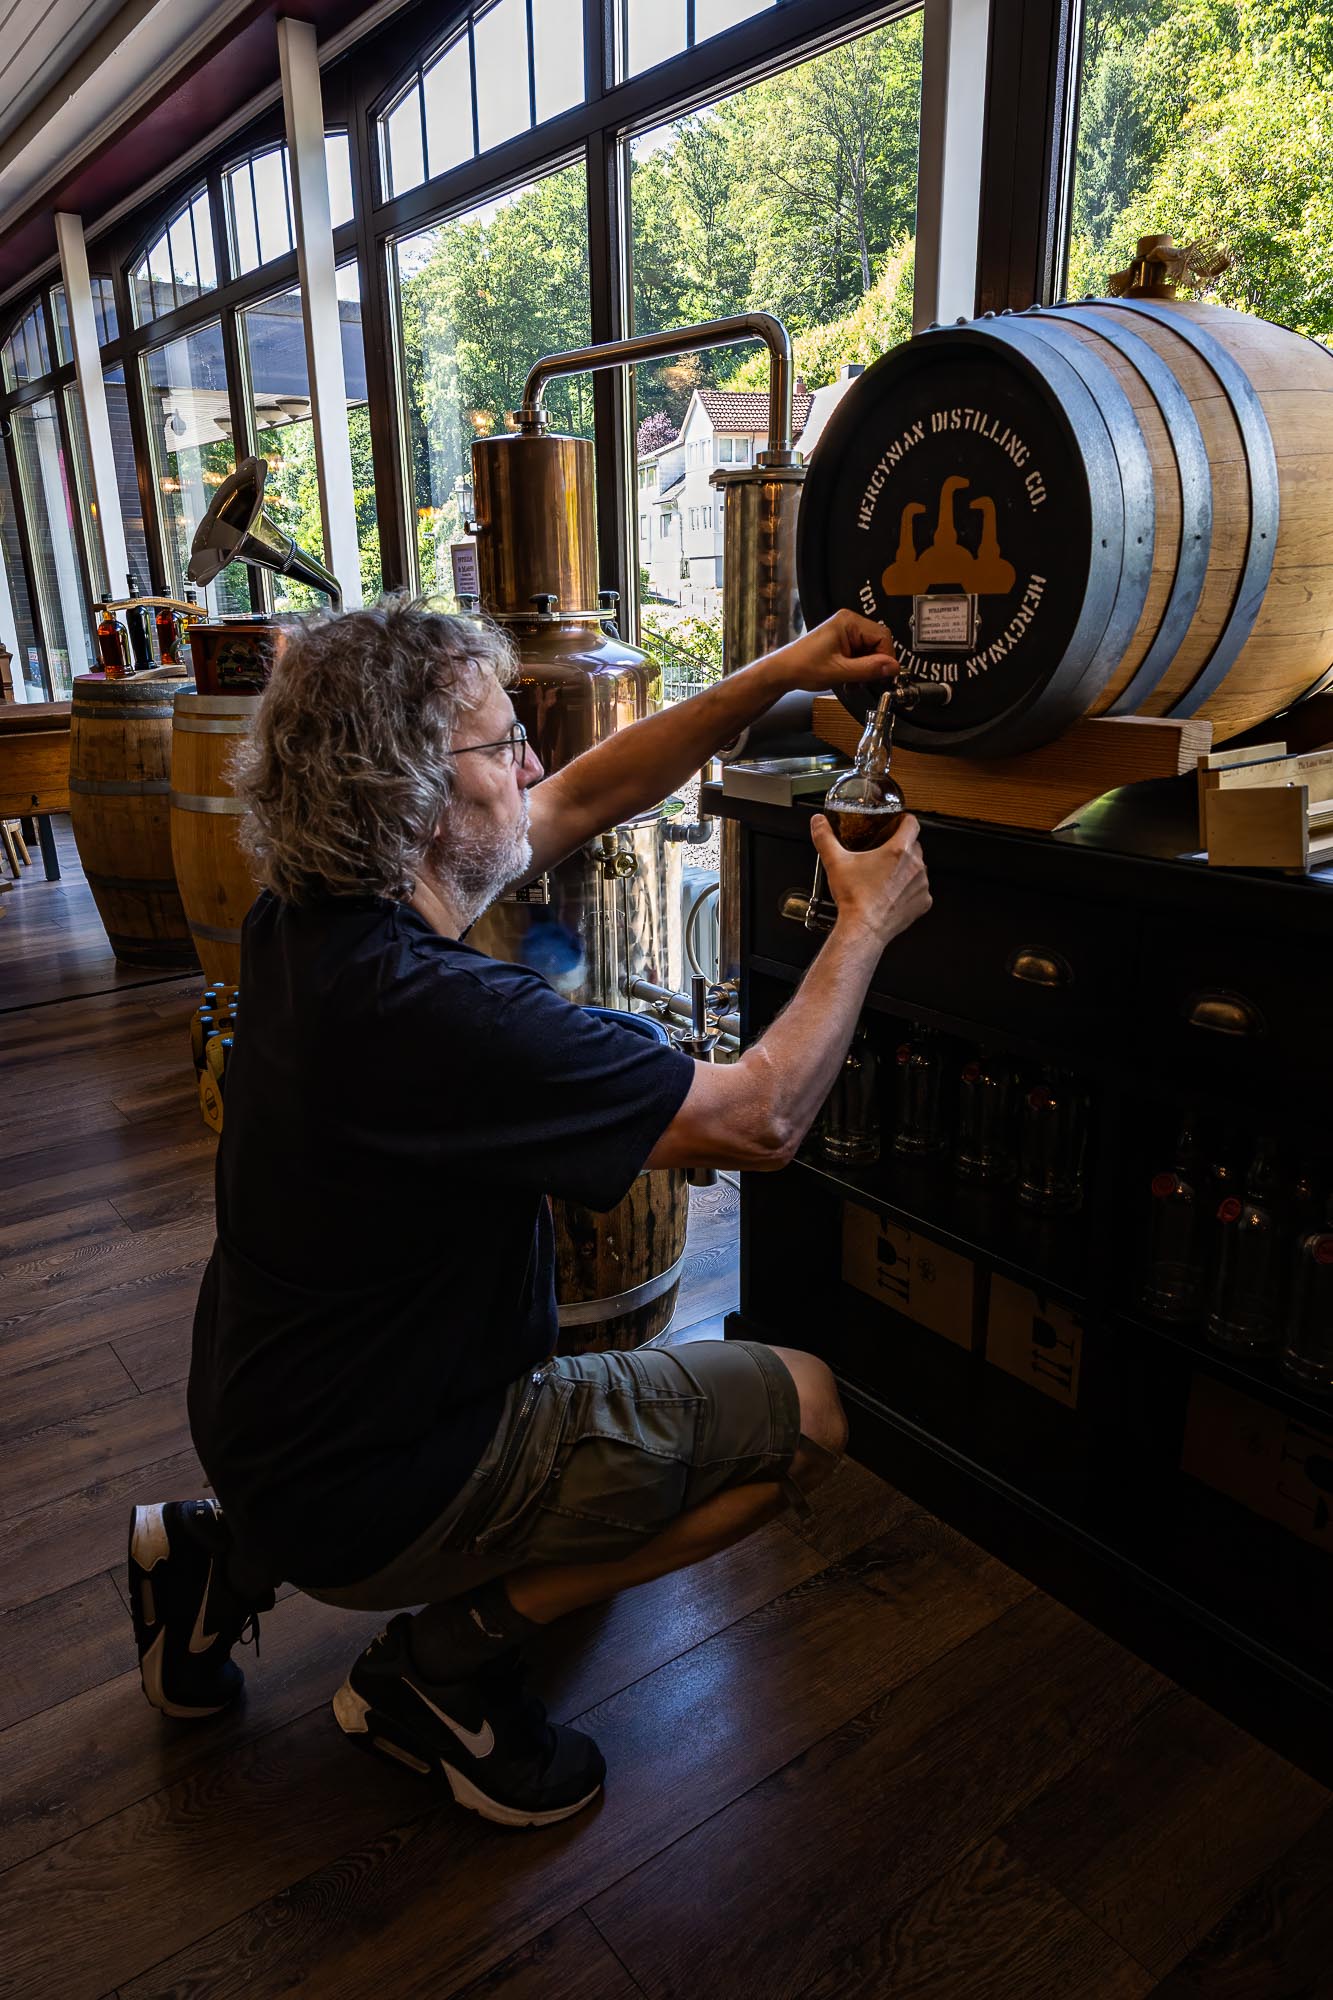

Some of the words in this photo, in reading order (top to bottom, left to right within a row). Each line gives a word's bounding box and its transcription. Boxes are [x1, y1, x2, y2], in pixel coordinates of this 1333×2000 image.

[857, 420, 926, 531] HERCYNIAN
[931, 408, 1030, 468] DISTILLING
[1025, 471, 1047, 513] CO.
[966, 574, 1047, 678] HERCYNIAN
